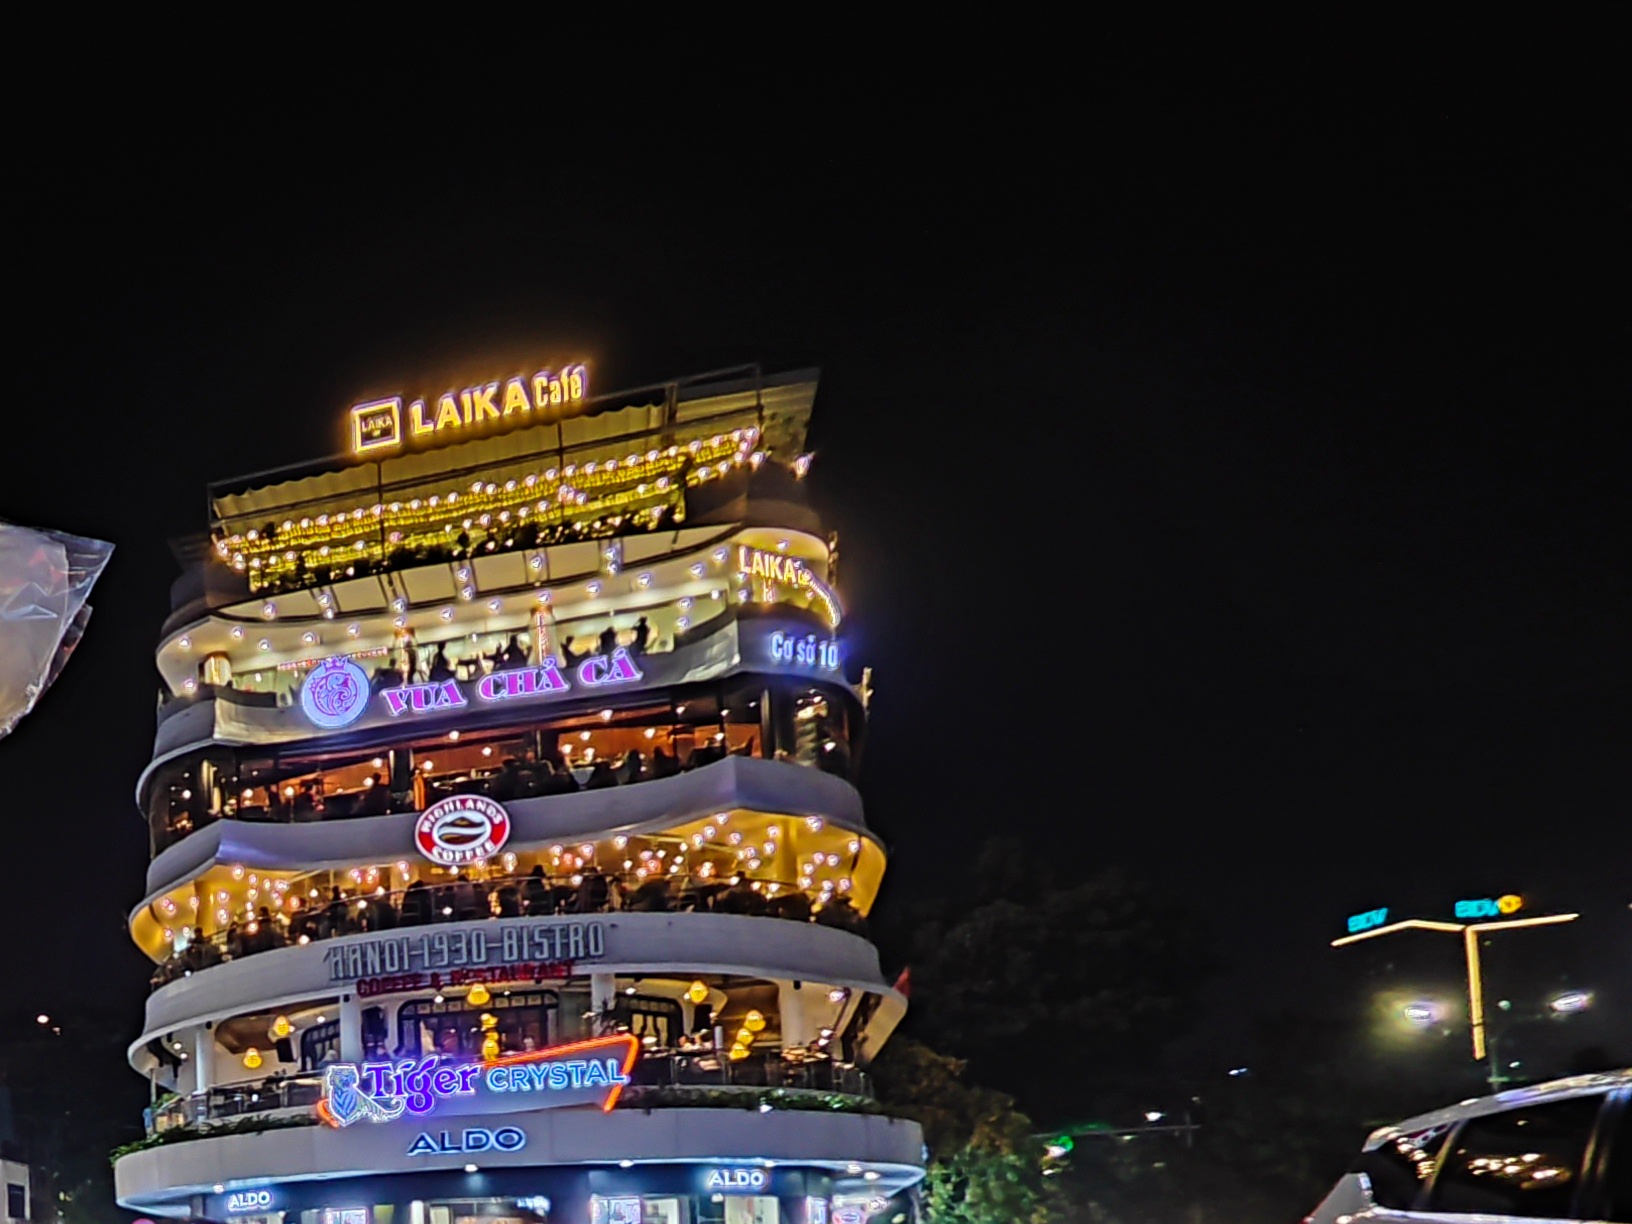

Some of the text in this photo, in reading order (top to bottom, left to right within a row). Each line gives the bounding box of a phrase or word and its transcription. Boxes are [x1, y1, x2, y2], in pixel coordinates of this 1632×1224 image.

[411, 364, 586, 435] LAIKA Café
[361, 415, 394, 433] LAIKA
[738, 545, 797, 584] LAIKA
[818, 640, 839, 669] 10
[380, 646, 644, 717] VUA CHẢ CÁ
[420, 798, 504, 833] HIGHLANDS
[431, 839, 496, 862] COFFEE
[362, 1053, 630, 1116] Tiger CRYSTAL
[406, 1126, 527, 1157] ALDO
[707, 1169, 765, 1187] ALDO
[227, 1190, 271, 1212] ALDO
